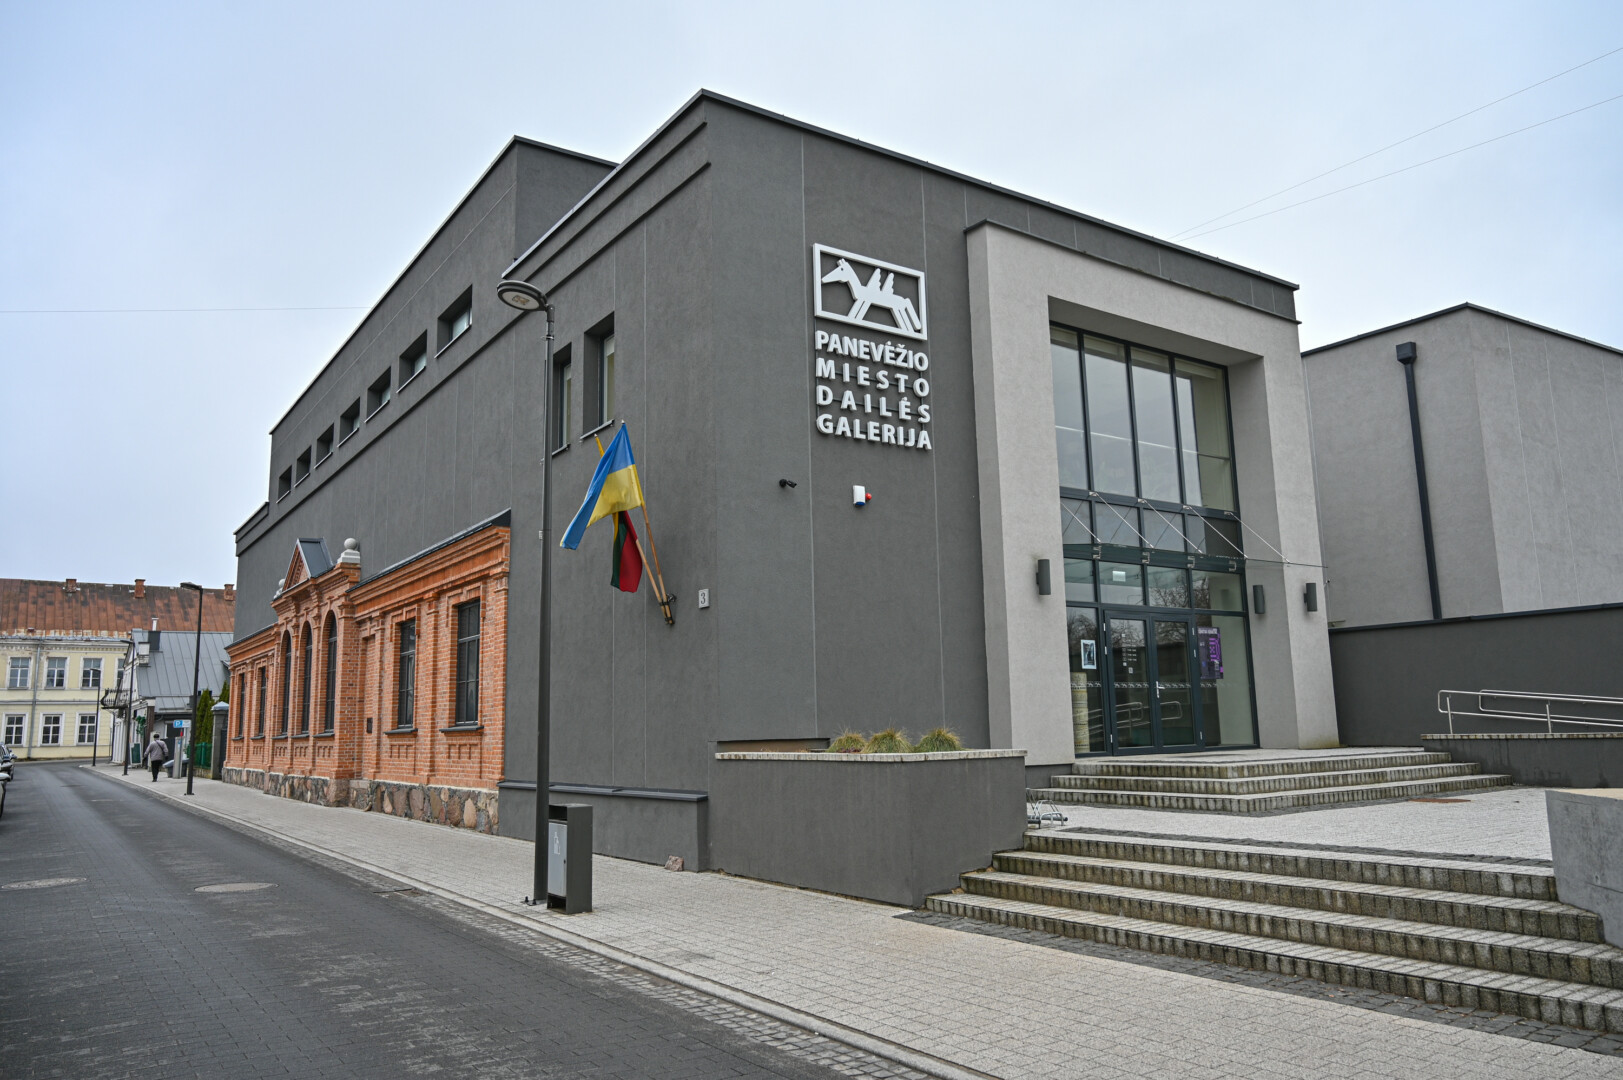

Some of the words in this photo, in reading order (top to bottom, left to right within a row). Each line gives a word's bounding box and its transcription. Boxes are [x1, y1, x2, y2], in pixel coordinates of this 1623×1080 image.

[815, 330, 929, 372] PANEVĖŽIO
[816, 357, 930, 397] MIESTO
[816, 385, 931, 424] DAILĖS
[816, 413, 932, 450] GALERIJA
[701, 592, 706, 604] 3
